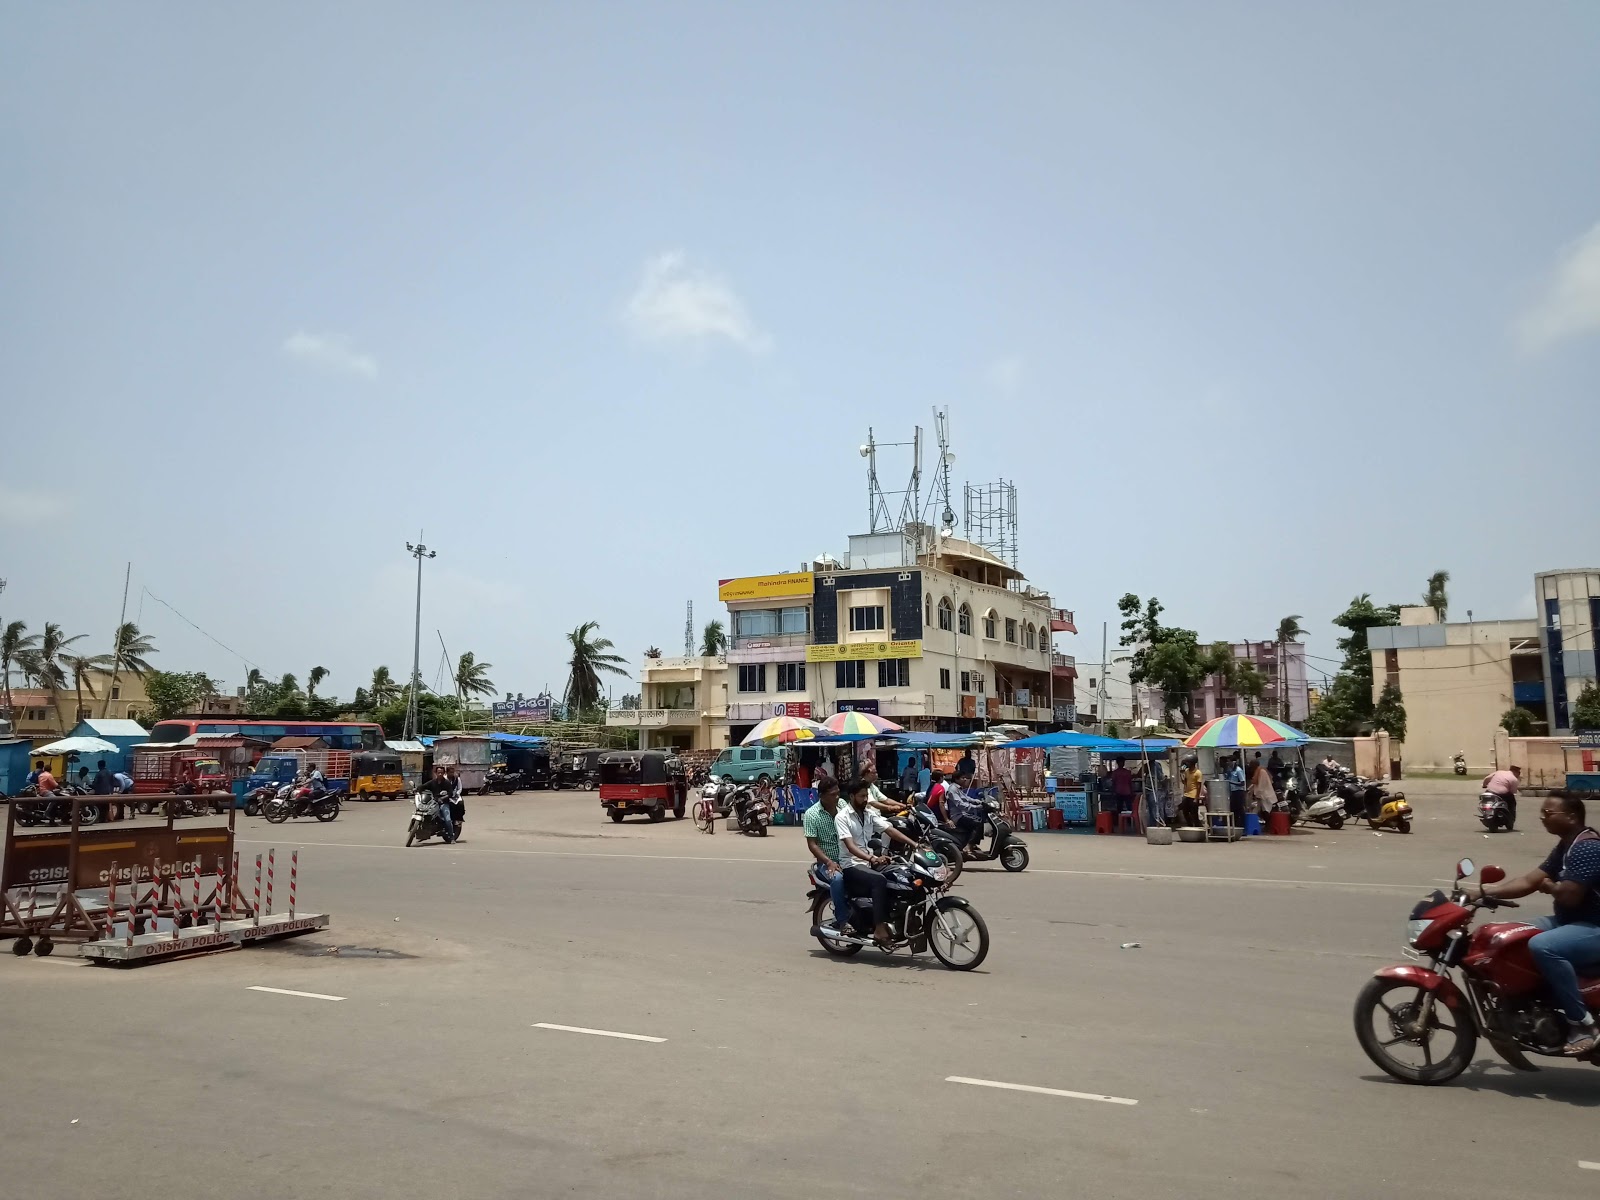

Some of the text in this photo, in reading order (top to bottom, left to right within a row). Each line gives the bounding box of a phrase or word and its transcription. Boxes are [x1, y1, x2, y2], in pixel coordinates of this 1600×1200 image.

[788, 577, 809, 585] FINANCE
[28, 866, 70, 881] ODISH
[99, 865, 151, 882] OISA
[282, 918, 315, 932] POLICE
